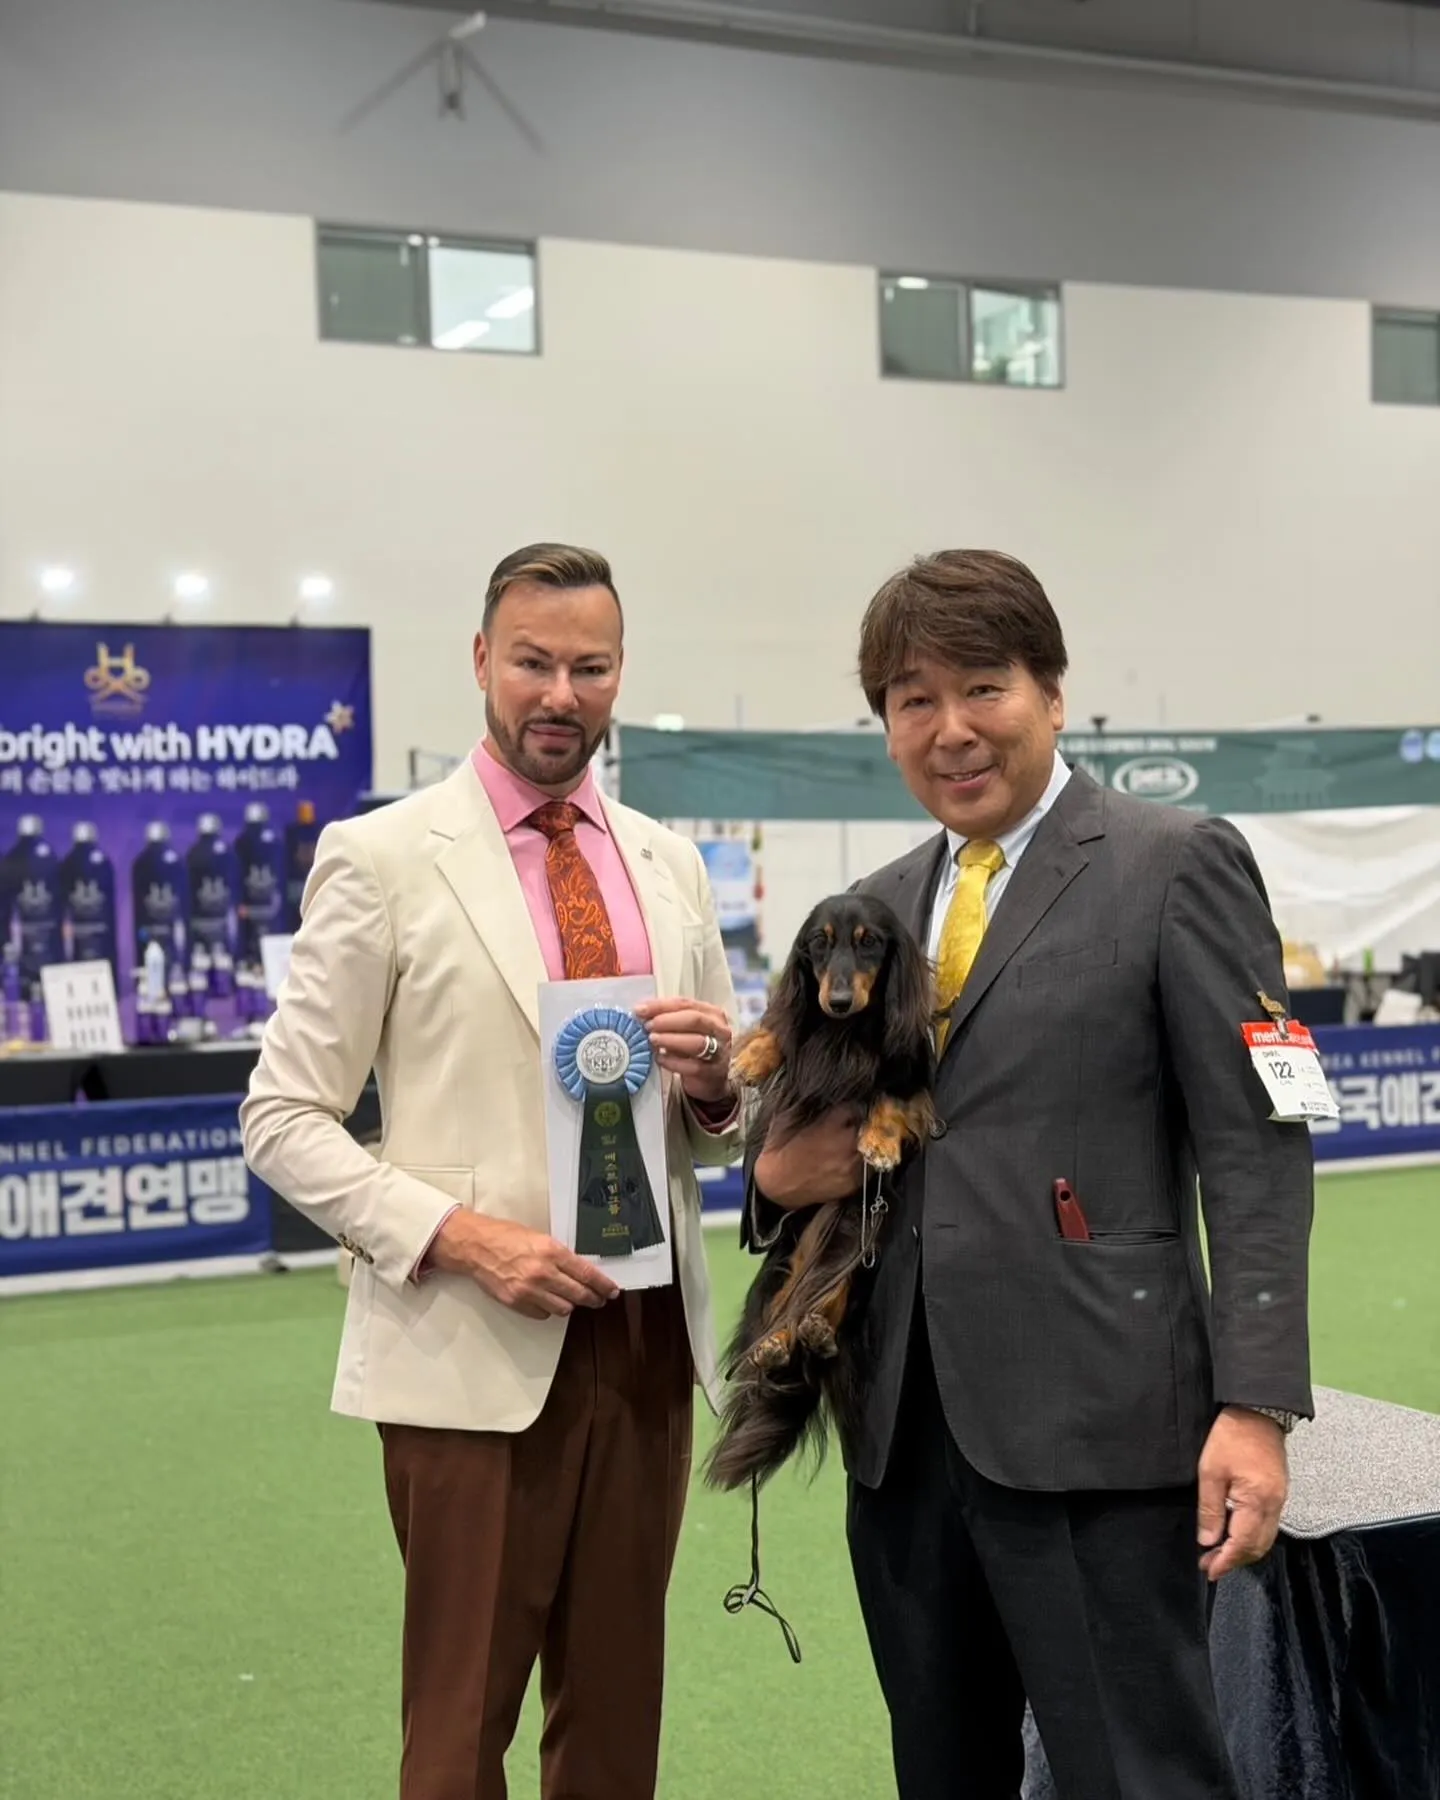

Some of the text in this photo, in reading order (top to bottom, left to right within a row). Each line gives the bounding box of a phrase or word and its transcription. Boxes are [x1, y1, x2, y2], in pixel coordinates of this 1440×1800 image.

[109, 721, 192, 761] with
[197, 723, 339, 761] HYDRA
[1268, 1061, 1295, 1079] 122
[80, 1128, 242, 1158] FEDERATION
[0, 1155, 250, 1240] 애견연맹
